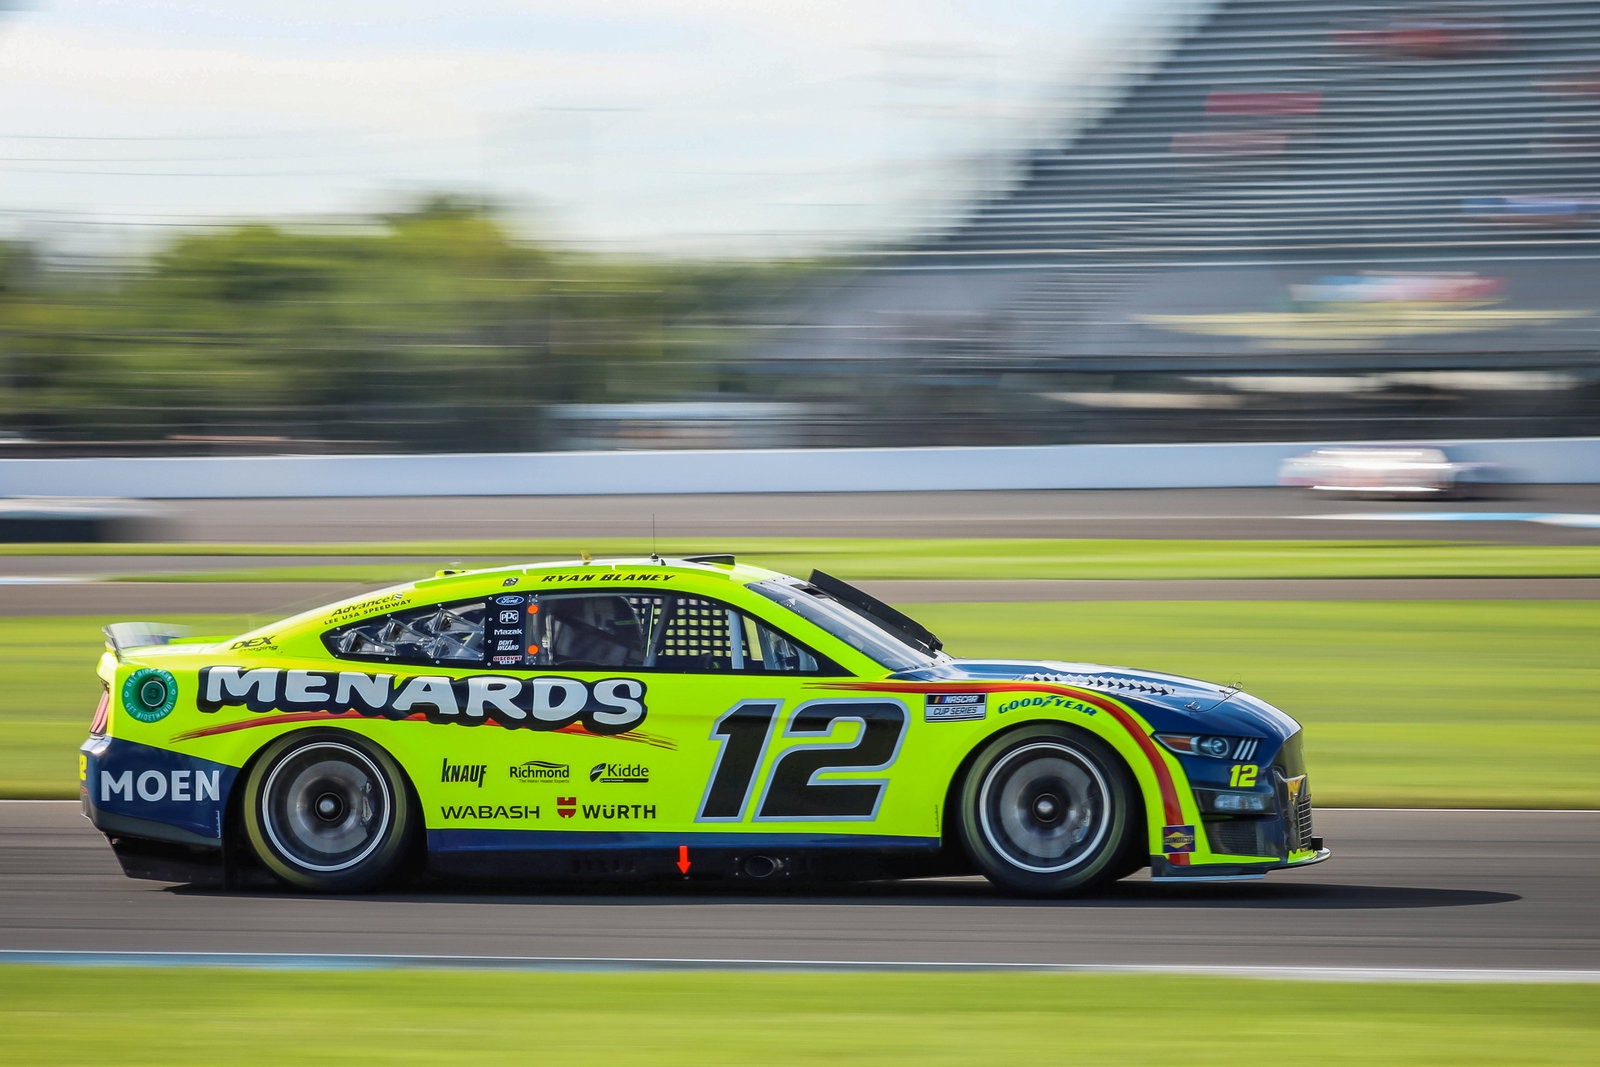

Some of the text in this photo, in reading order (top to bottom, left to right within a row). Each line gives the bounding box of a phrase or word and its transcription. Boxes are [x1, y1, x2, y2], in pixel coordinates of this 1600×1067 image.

[541, 574, 595, 582] RYAN
[324, 598, 412, 625] LEE USA SPEEDWAY
[332, 596, 392, 616] Advance
[501, 612, 518, 622] PPG
[230, 635, 276, 649] DEX
[198, 665, 647, 733] MENARDS
[998, 695, 1098, 716] GOODYEAR
[933, 706, 977, 715] CUP SERIES
[693, 697, 911, 823] 12
[509, 765, 570, 778] Richmond
[607, 764, 649, 777] Kidde
[1230, 765, 1258, 787] 12
[100, 770, 221, 802] MOEN
[441, 806, 540, 819] WABASH
